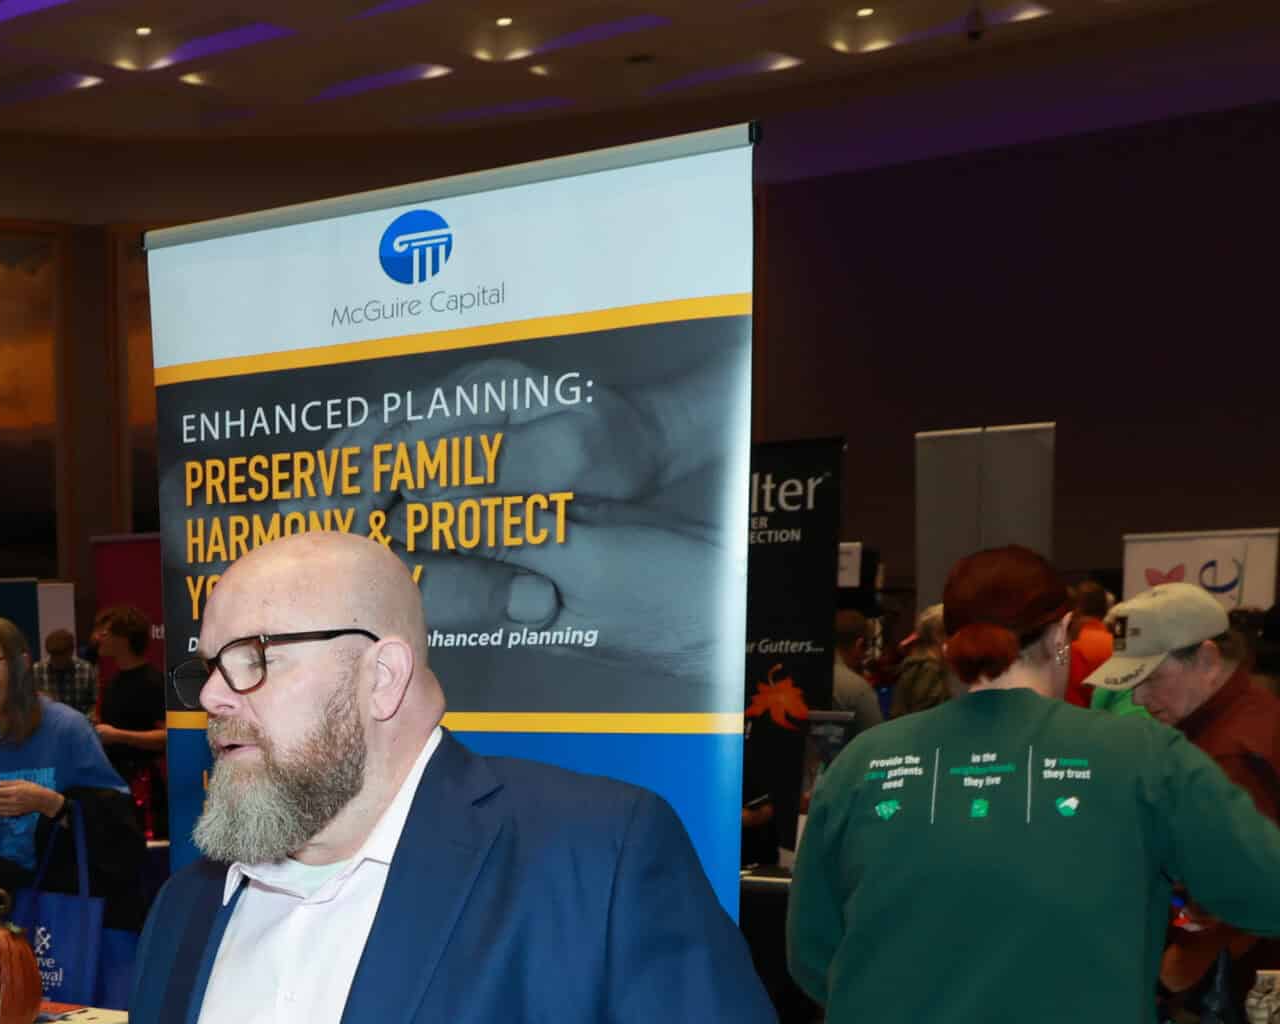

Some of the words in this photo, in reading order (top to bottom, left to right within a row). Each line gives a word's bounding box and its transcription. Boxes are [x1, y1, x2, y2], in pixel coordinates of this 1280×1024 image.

[330, 297, 422, 328] McGuire
[430, 282, 505, 315] Capital
[182, 396, 369, 444] ENHANCED
[383, 371, 595, 424] PLANNING:
[185, 446, 361, 507] PRESERVE
[373, 432, 504, 493] FAMILY
[368, 514, 392, 546] &
[407, 492, 574, 552] PROTECT
[427, 627, 504, 647] hanced
[508, 626, 599, 649] planning
[887, 766, 924, 779] patients
[963, 776, 985, 788] they
[1043, 769, 1065, 780] they
[1066, 768, 1091, 779] trust
